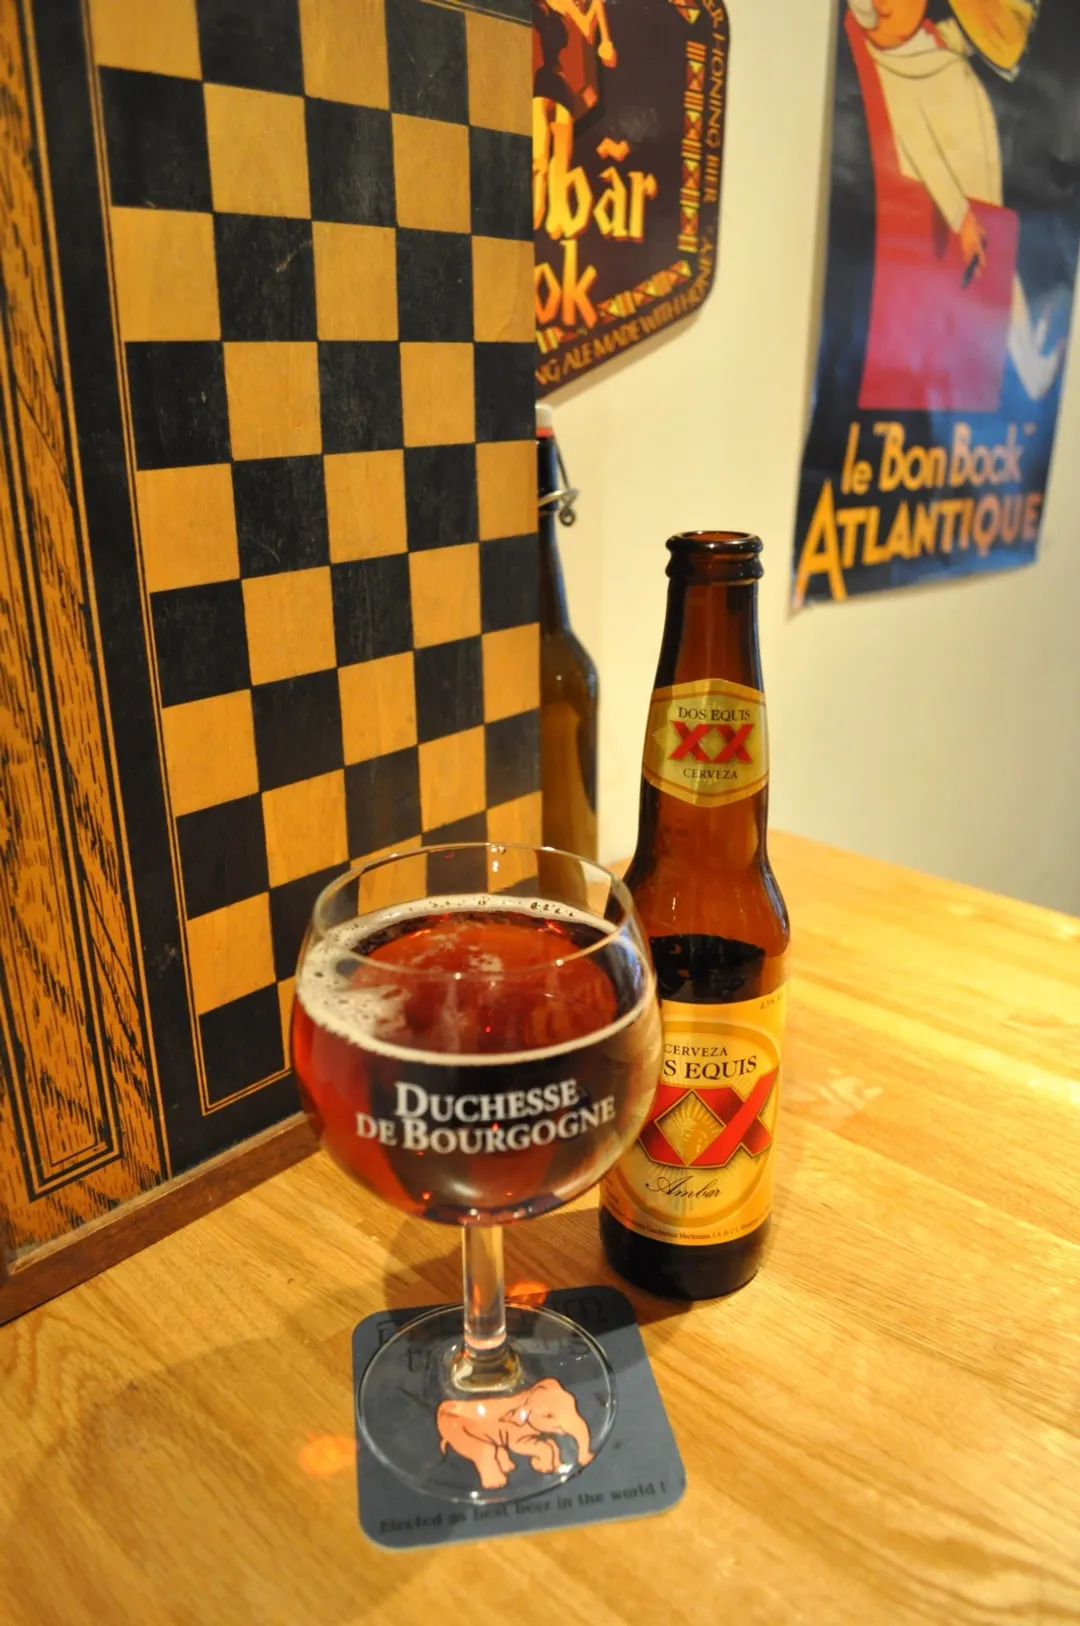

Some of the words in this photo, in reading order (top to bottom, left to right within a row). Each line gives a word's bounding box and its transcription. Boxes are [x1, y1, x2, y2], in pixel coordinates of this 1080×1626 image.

[534, 239, 598, 330] ok
[593, 320, 641, 359] MADE
[840, 421, 873, 496] le
[792, 478, 1043, 608] ATLANTIQUE
[678, 706, 707, 720] DOS
[711, 708, 751, 722] EQUIS
[667, 719, 755, 765] XX
[683, 767, 738, 781] CERVEZA
[664, 1043, 729, 1058] CERVEZA
[684, 1054, 757, 1081] EQUIS
[394, 1078, 581, 1124] DUCHESSE
[355, 1110, 398, 1147] DE
[401, 1095, 617, 1155] BOURGOGNE
[556, 1494, 573, 1510] in
[577, 1491, 605, 1507] the
[610, 1481, 656, 1501] world
